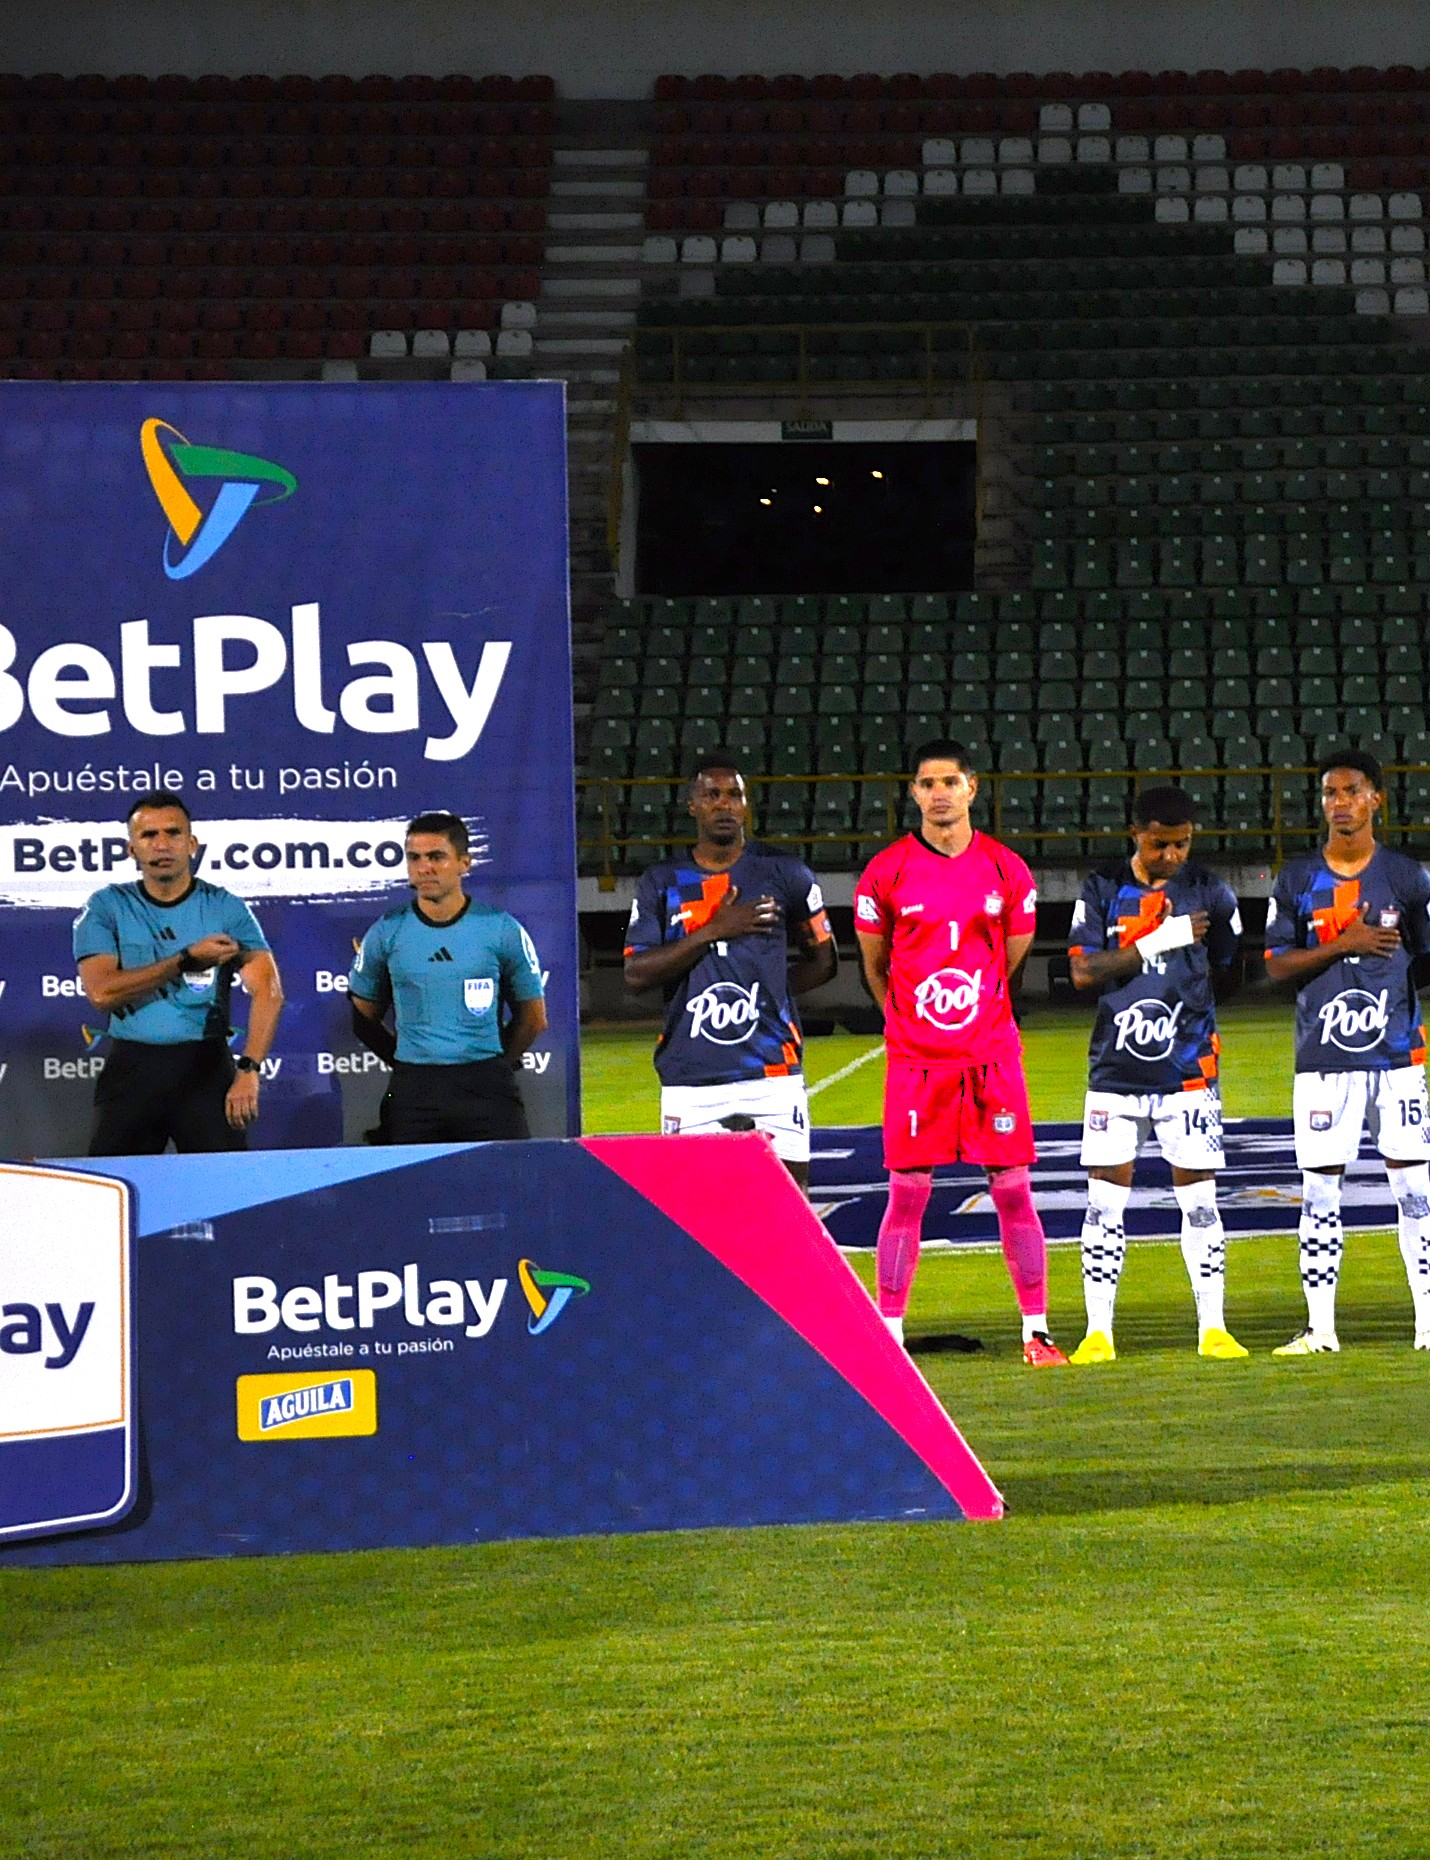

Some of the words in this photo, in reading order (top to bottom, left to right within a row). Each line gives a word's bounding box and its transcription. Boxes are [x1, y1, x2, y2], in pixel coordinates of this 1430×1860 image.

[0, 763, 184, 797] Apuéstale
[196, 773, 216, 790] a
[229, 763, 264, 790] tu
[279, 761, 398, 795] pasión
[13, 836, 404, 873] BetP.com.co
[948, 921, 959, 951] 1
[468, 982, 490, 990] FIFA
[915, 970, 982, 1018] Pool
[686, 981, 760, 1038] Pool
[1114, 1001, 1183, 1050] Pool
[1318, 989, 1388, 1044] Pool
[44, 1057, 105, 1079] BetP
[909, 1110, 917, 1136] 1
[1182, 1109, 1207, 1134] 14
[1398, 1099, 1421, 1126] 15
[233, 1263, 508, 1337] BetPlay
[267, 1342, 353, 1361] Apuéstale
[359, 1345, 369, 1355] a
[375, 1341, 392, 1355] tu
[398, 1338, 454, 1355] pasión
[266, 1384, 346, 1427] AGUILA
